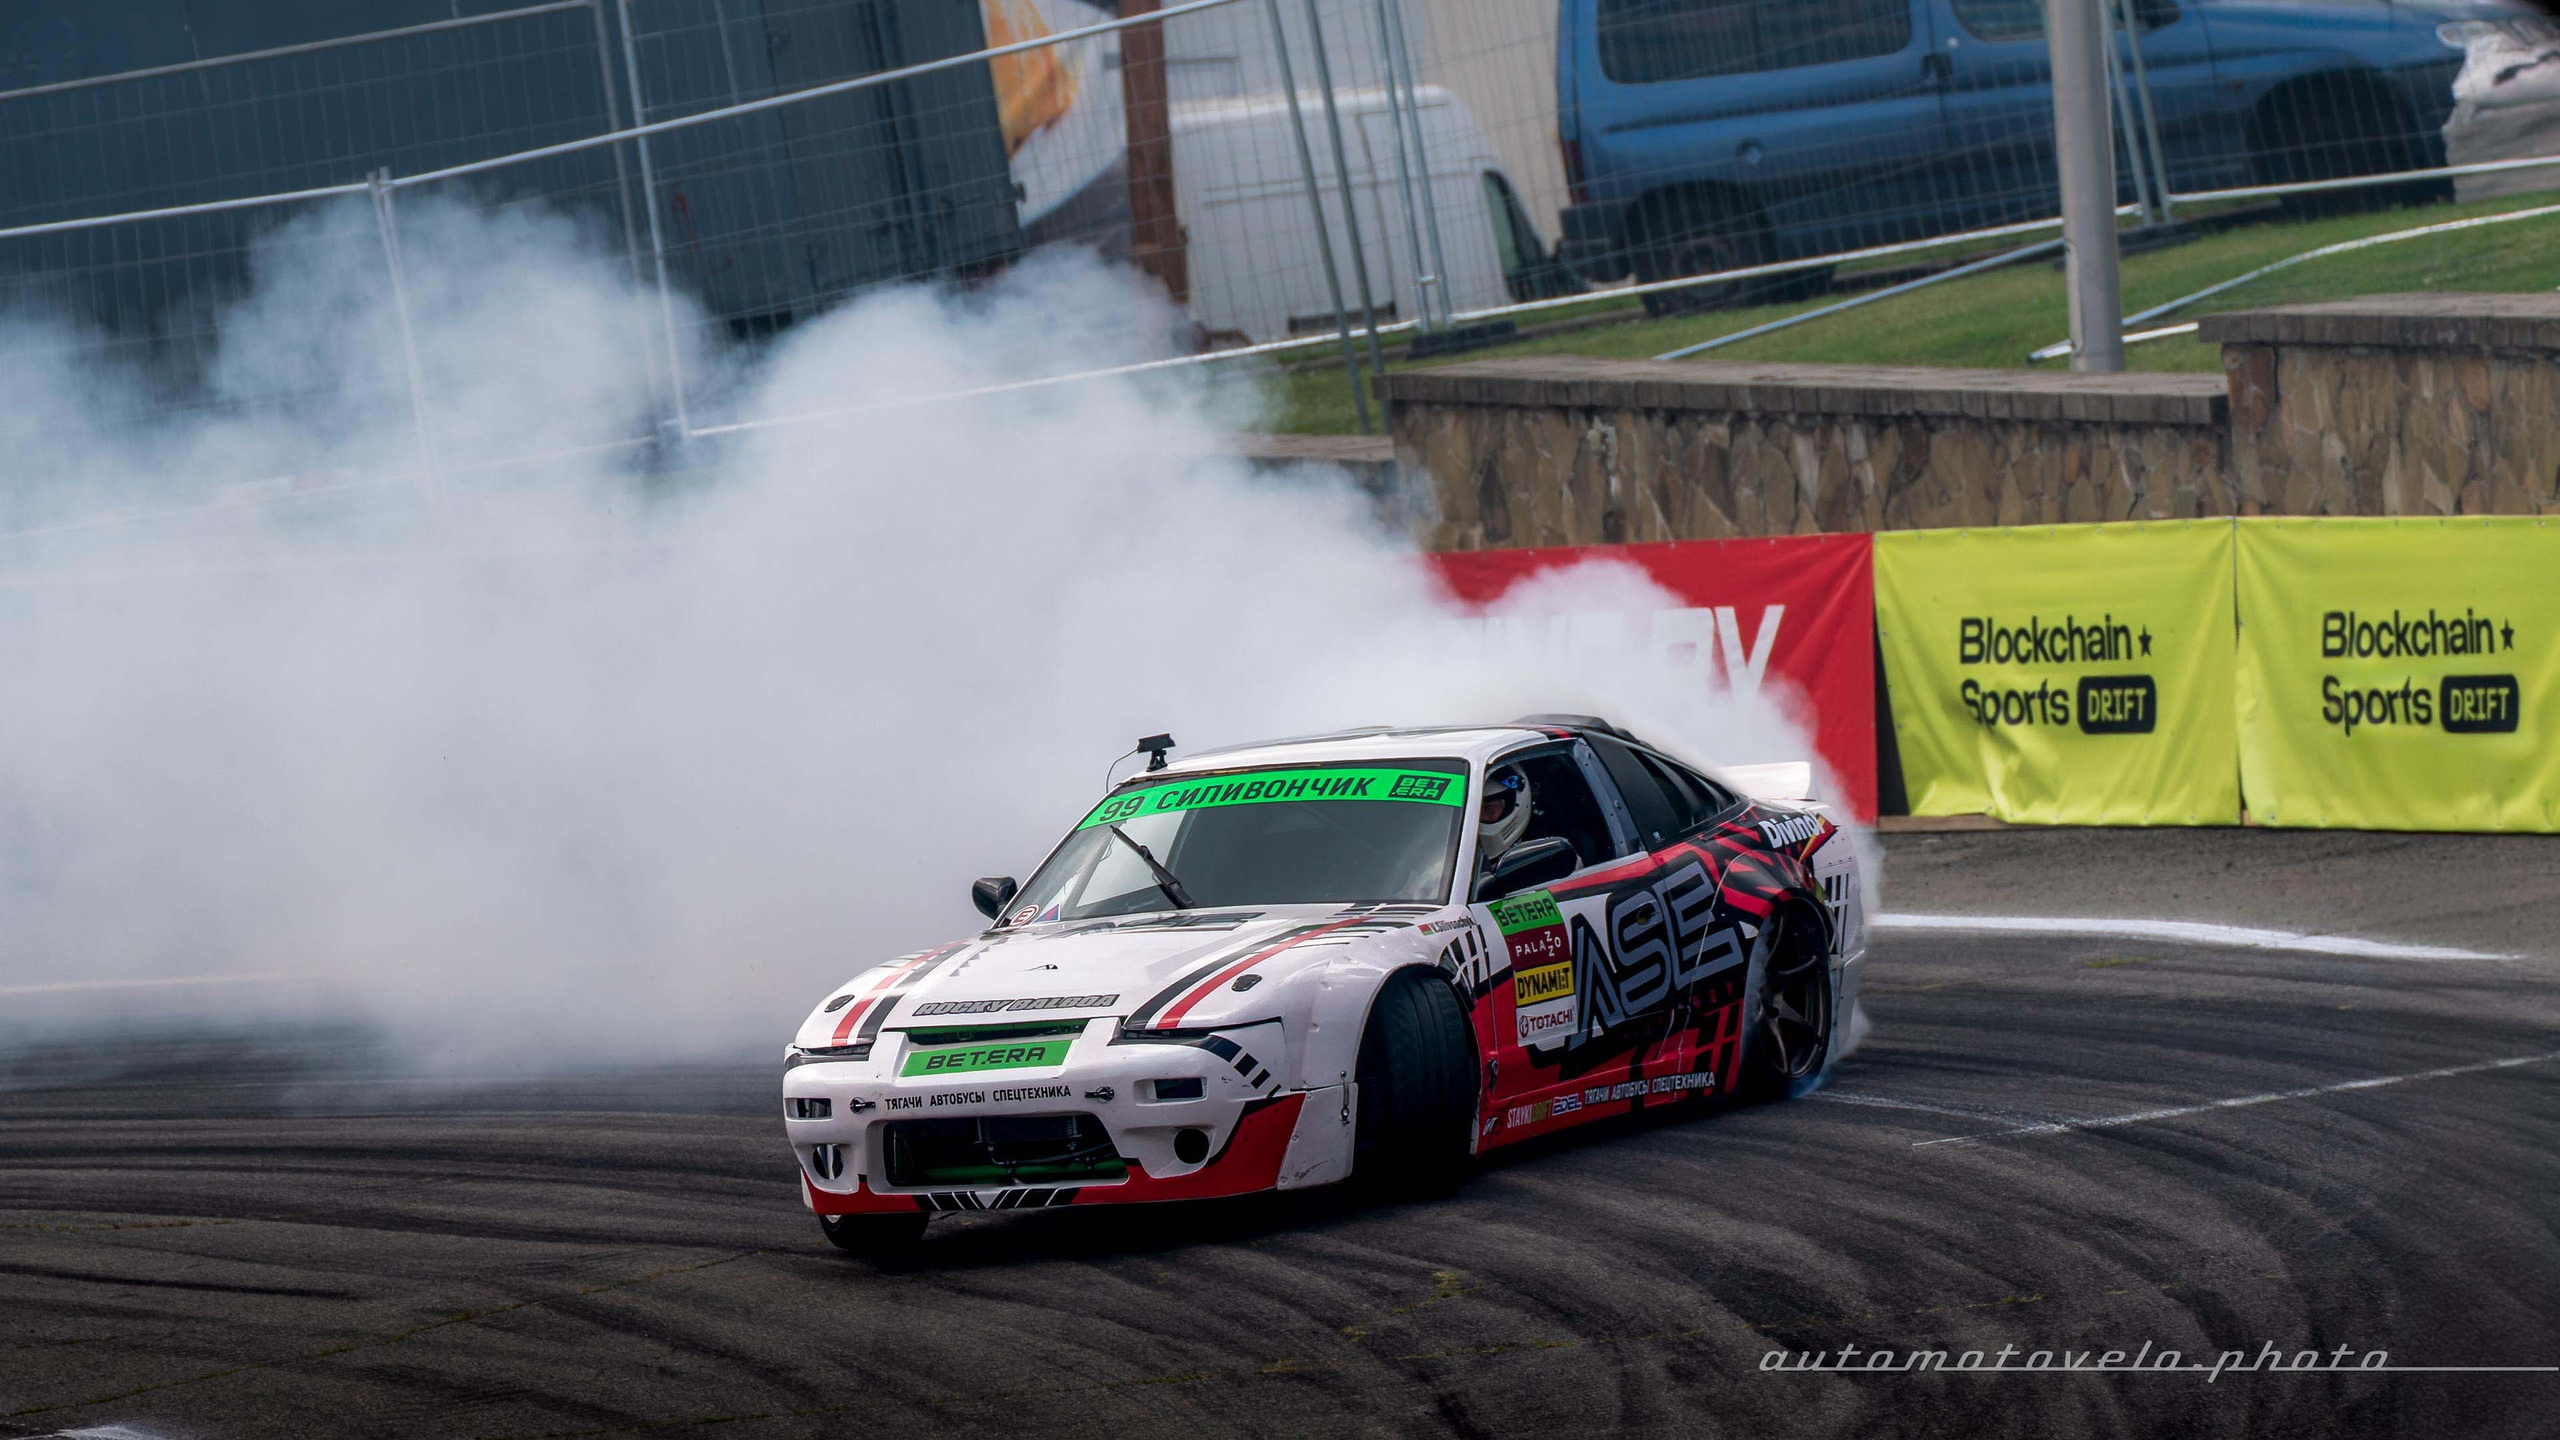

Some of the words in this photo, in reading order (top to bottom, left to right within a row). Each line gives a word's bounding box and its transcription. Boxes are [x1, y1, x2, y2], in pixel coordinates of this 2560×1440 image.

[1960, 613, 2132, 664] Blockchain
[2323, 608, 2495, 658] Blockchain
[1961, 678, 2069, 727] Sports
[2087, 688, 2147, 722] DRIFT
[2322, 675, 2432, 737] Sports
[2451, 687, 2510, 722] DRIFT
[1100, 796, 1145, 821] 99
[1156, 777, 1376, 810] СИЛИВОНЧИК
[1758, 810, 1825, 849] Divinol
[1568, 860, 1744, 1051] ASE
[912, 998, 1015, 1017] ROCKY
[1006, 993, 1120, 1012] BALBOA
[1530, 1008, 1573, 1032] TOTACHI
[885, 1096, 923, 1111] ТЯГАЧИ
[930, 1091, 986, 1107] АВТОБУСЫ
[993, 1085, 1072, 1103] СПЕЦТЕХНИКА
[1652, 1071, 1716, 1094] СПЕЦТЕХНИКА
